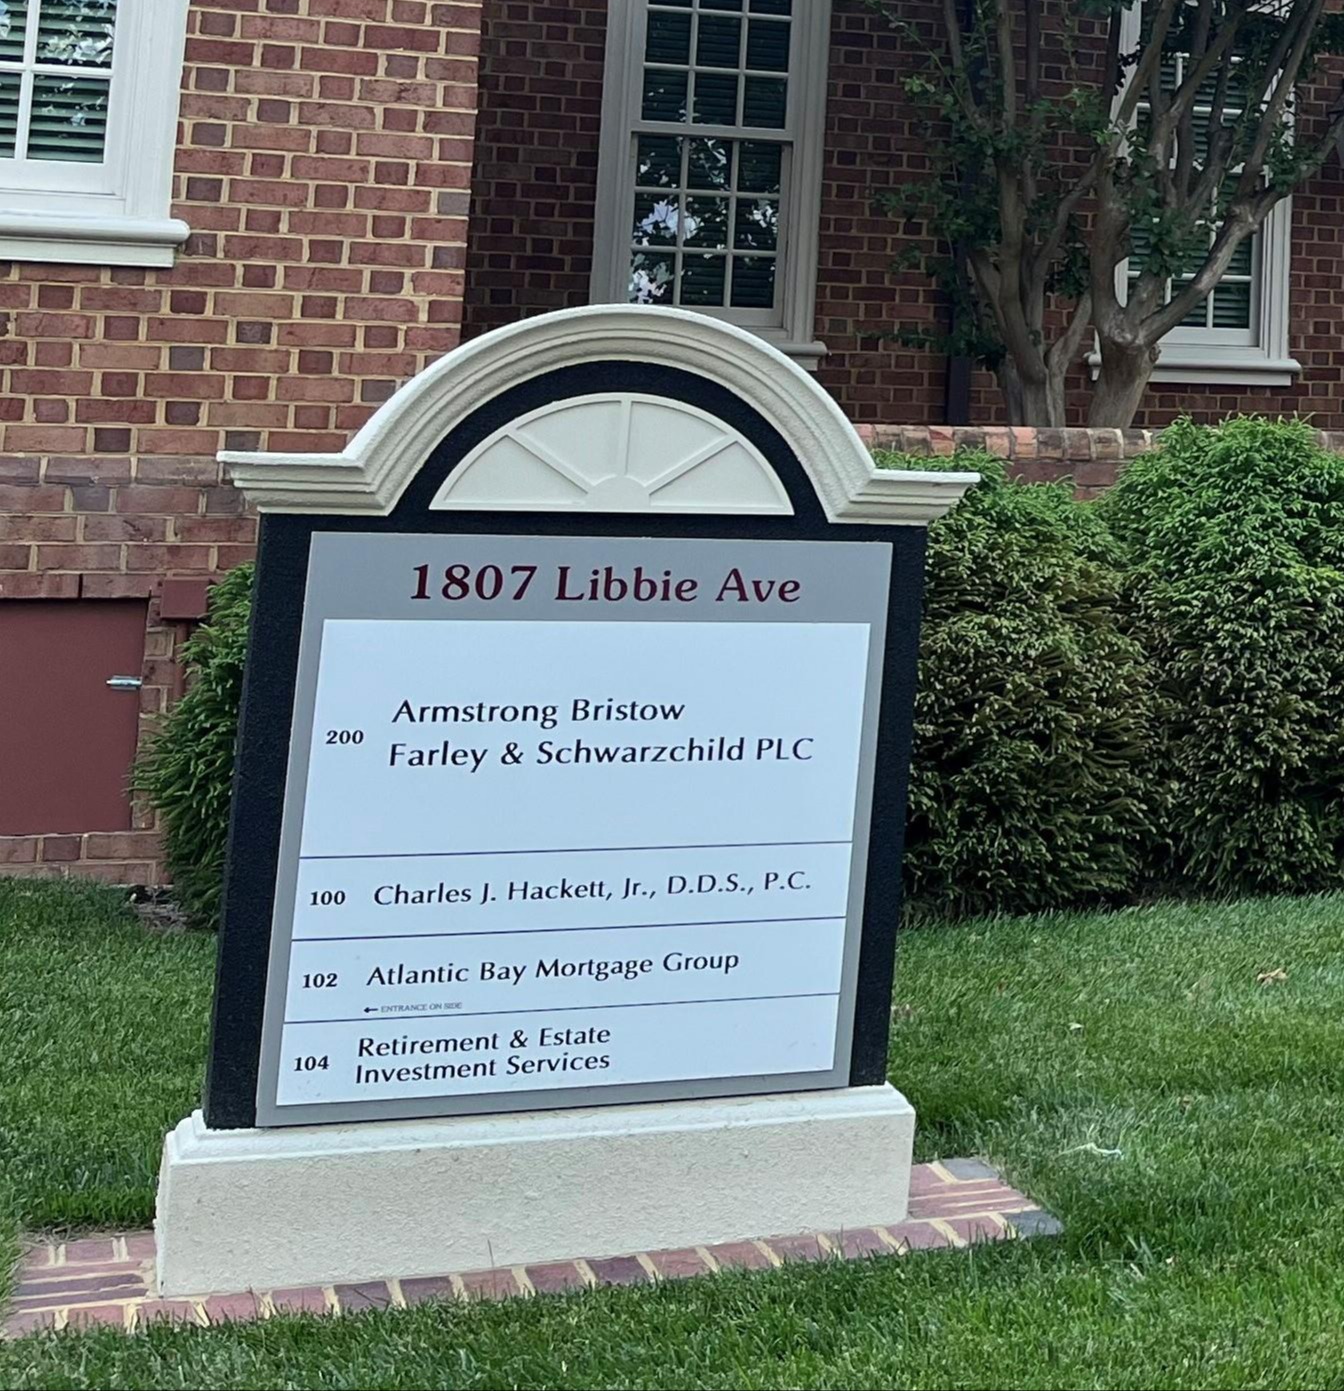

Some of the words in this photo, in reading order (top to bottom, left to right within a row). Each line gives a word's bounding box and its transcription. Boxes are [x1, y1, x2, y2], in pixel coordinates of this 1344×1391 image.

[410, 563, 538, 601] 1807
[554, 566, 698, 602] Libbie
[715, 567, 801, 603] Ave
[391, 699, 559, 730] Armstrong
[571, 697, 686, 722] Bristow
[325, 729, 364, 745] 200
[389, 741, 489, 774] Farley
[500, 742, 524, 765] &
[536, 736, 745, 765] Schwarzchild
[756, 737, 814, 761] PLC
[310, 890, 346, 906] 100
[373, 882, 472, 906] Charles
[480, 882, 497, 905] J.
[508, 877, 613, 901] Hackett,
[622, 877, 656, 900] Jr.,
[667, 873, 754, 895] D.D.S.,
[764, 871, 811, 891] P.C.
[303, 972, 338, 989] 102
[365, 962, 469, 986] Atlantic
[480, 961, 527, 986] Bay
[535, 958, 653, 982] Mortgage
[662, 952, 739, 975] Group
[380, 1004, 427, 1013] ENTRANCE
[429, 1003, 442, 1011] ON
[444, 1002, 462, 1010] SIDE
[358, 1032, 499, 1058] Retirement
[509, 1029, 529, 1049] &
[539, 1027, 611, 1047] Estate
[294, 1055, 330, 1072] 104
[356, 1056, 496, 1084] Investment
[505, 1051, 610, 1075] Services
